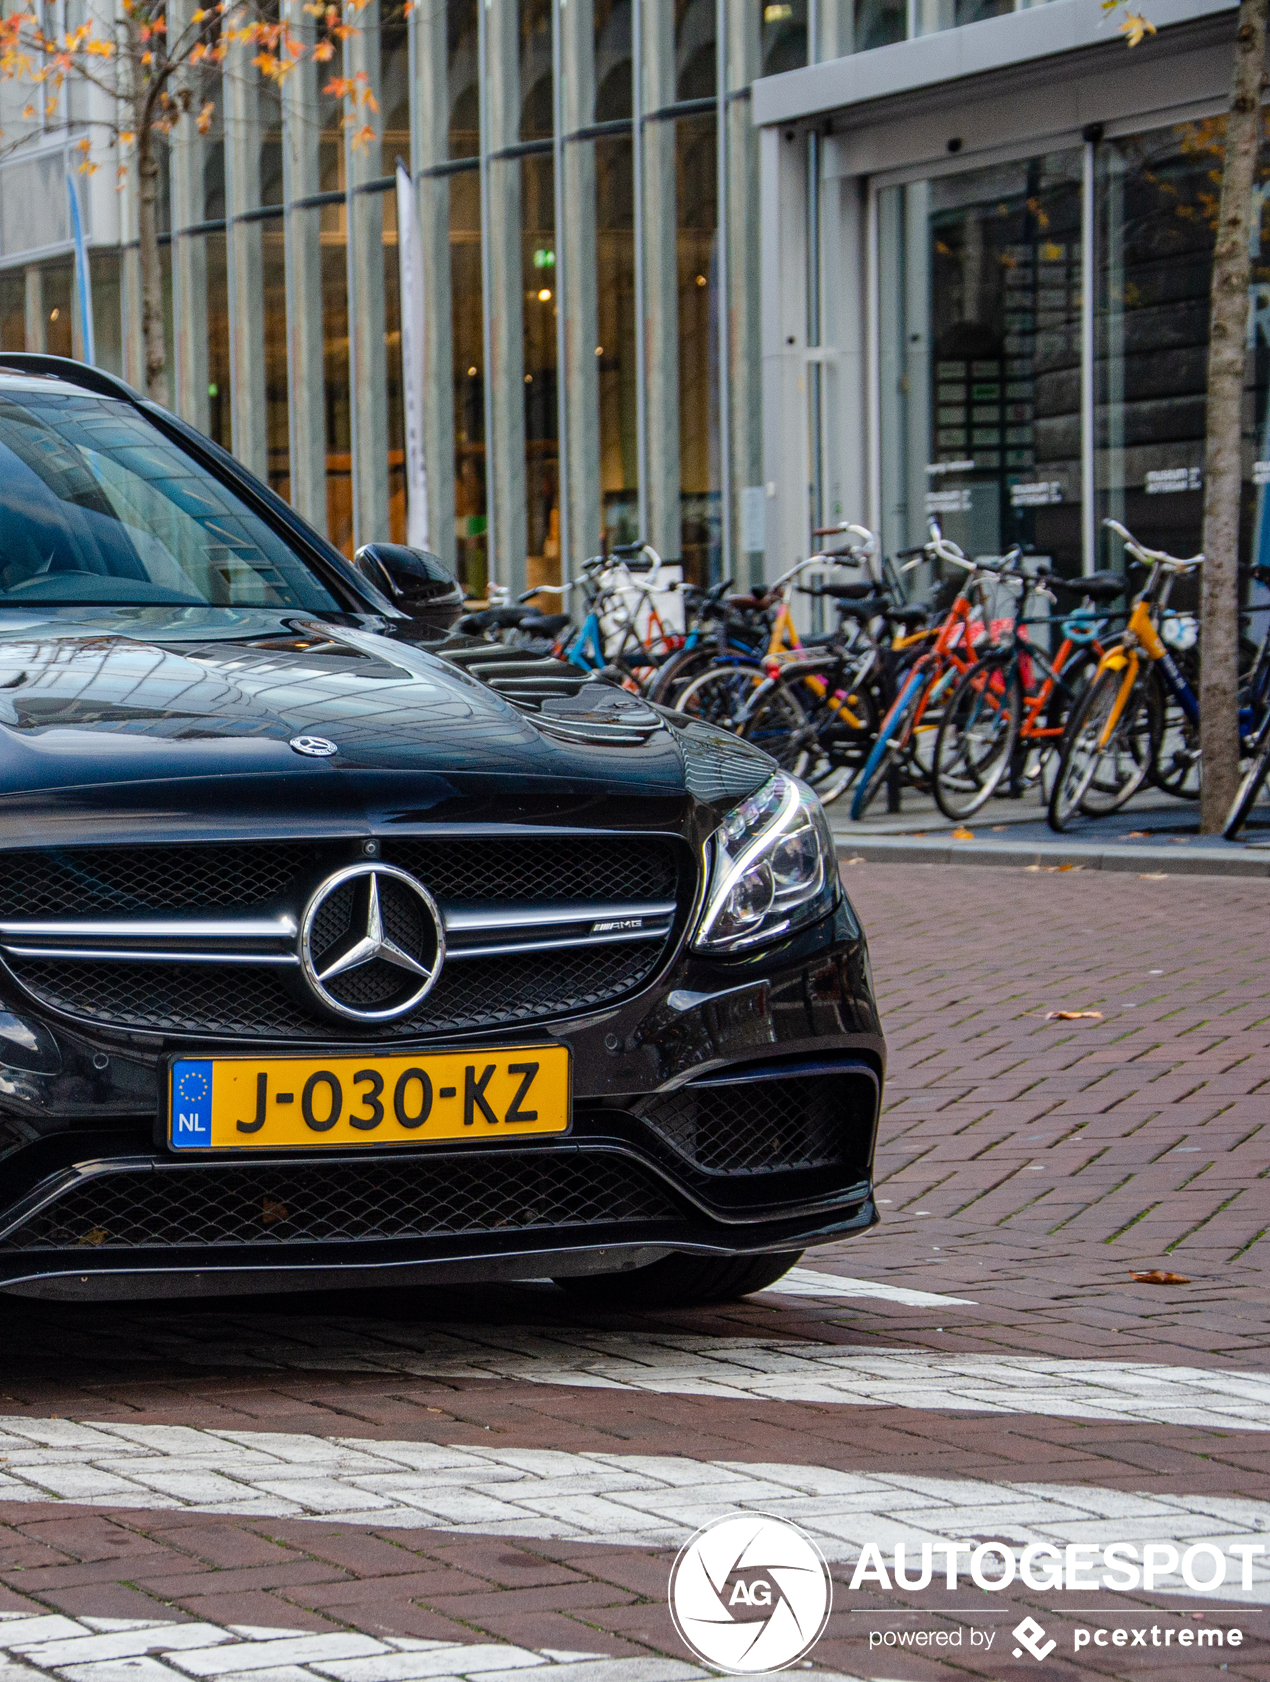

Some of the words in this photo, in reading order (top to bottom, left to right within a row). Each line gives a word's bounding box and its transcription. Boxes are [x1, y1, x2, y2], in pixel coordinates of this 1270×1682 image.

[609, 919, 643, 930] AMG
[236, 1062, 540, 1133] J-030-KZ
[179, 1113, 206, 1132] NL
